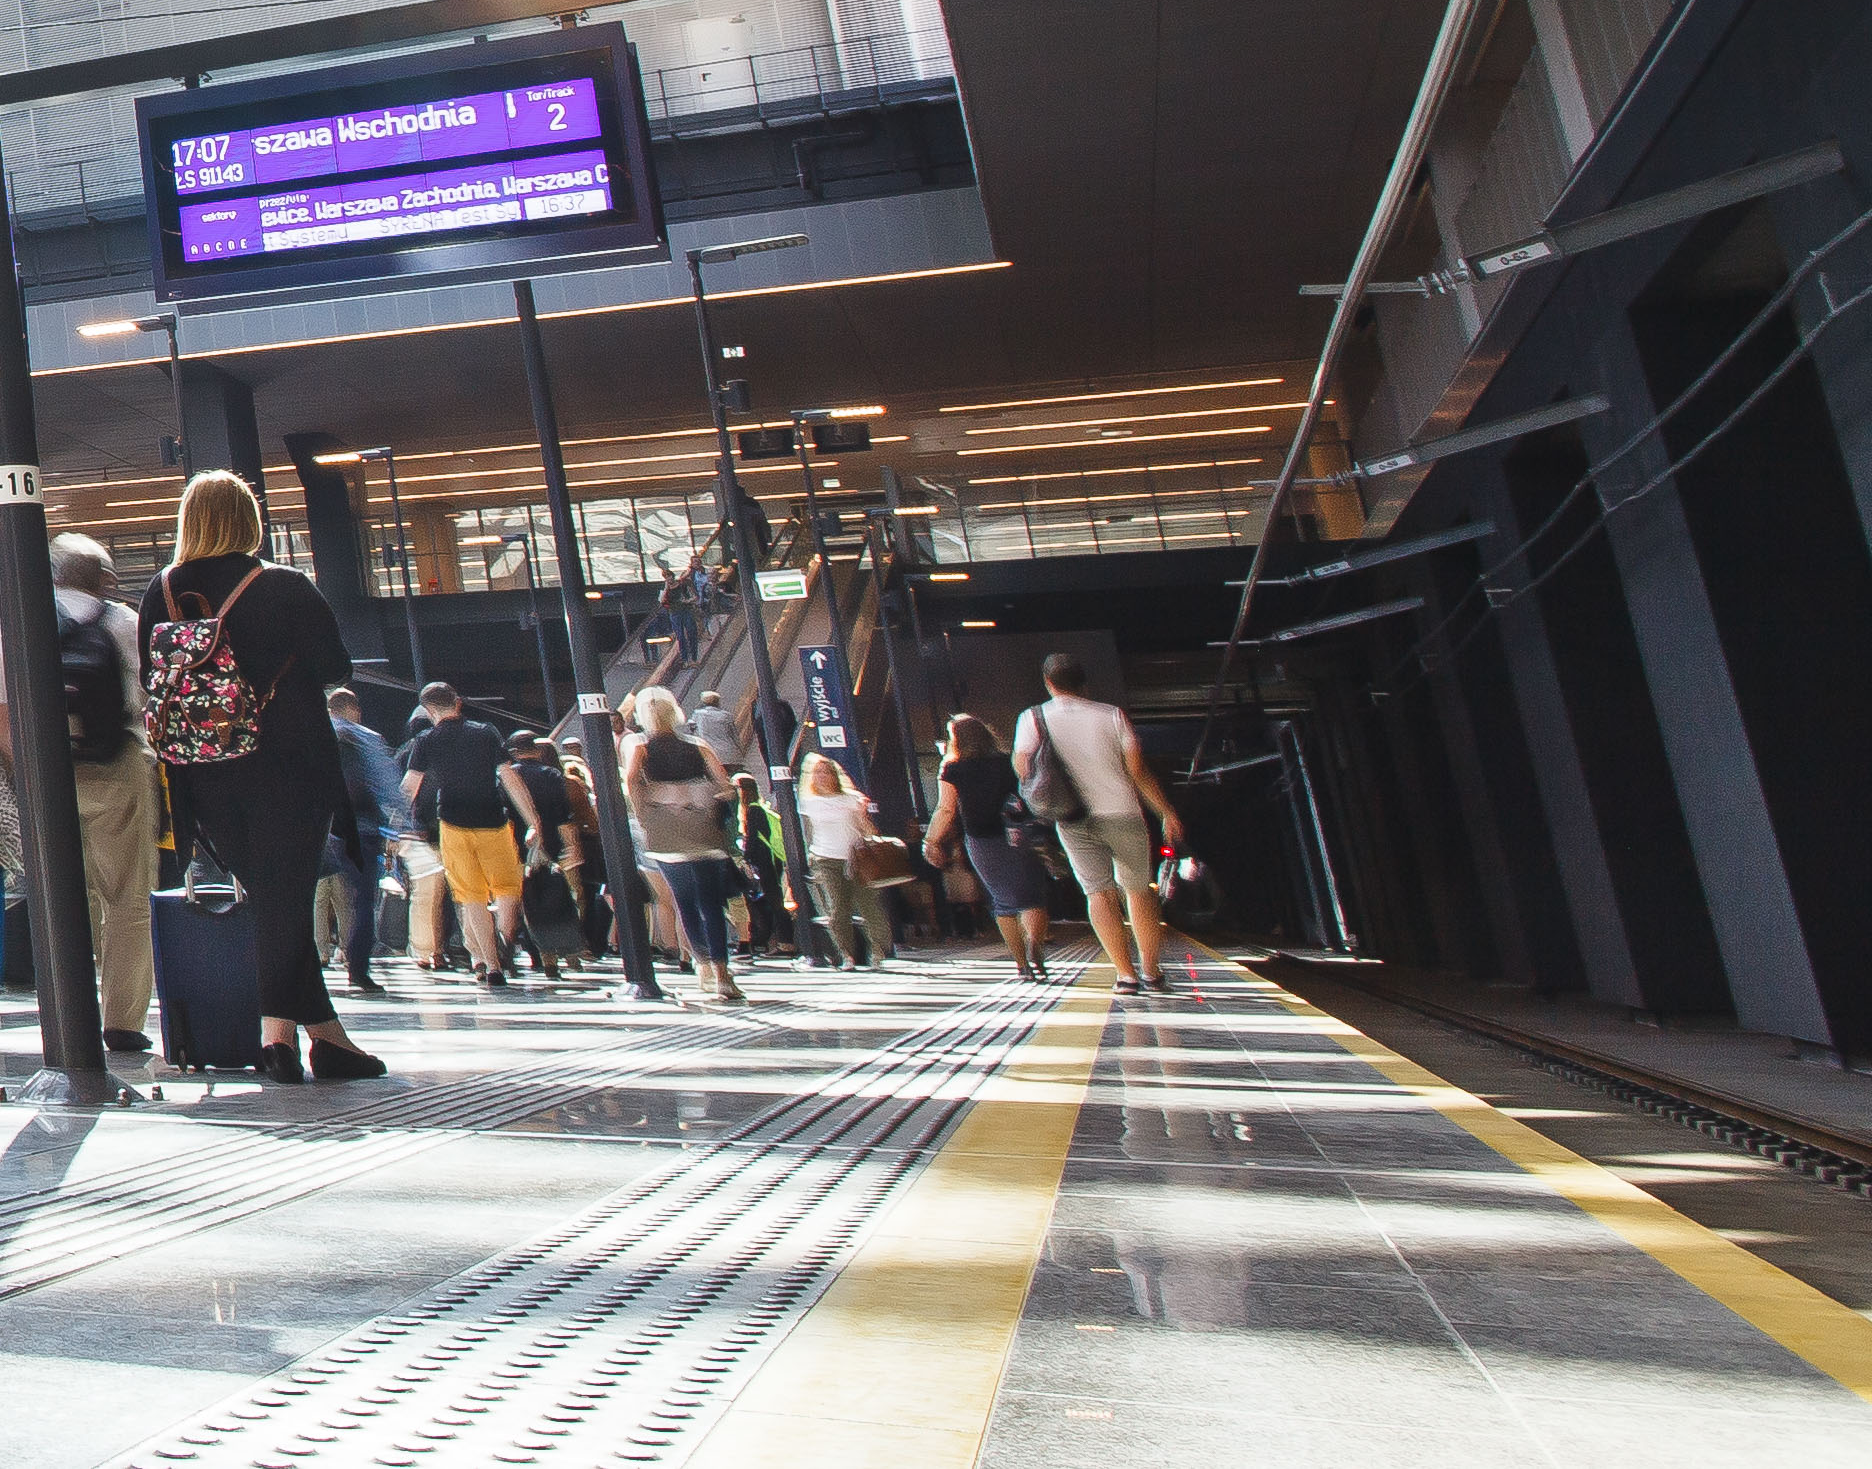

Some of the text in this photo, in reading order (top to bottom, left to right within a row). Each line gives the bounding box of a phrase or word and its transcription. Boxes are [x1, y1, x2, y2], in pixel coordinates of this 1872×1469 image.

[546, 103, 568, 131] 2
[171, 135, 230, 168] 17:07
[251, 127, 333, 155] szawa
[337, 101, 477, 143] Wschodnia
[199, 163, 244, 187] 91143
[314, 194, 399, 220] Warszawa
[502, 169, 593, 196] Warszawa
[822, 734, 844, 743] WC
